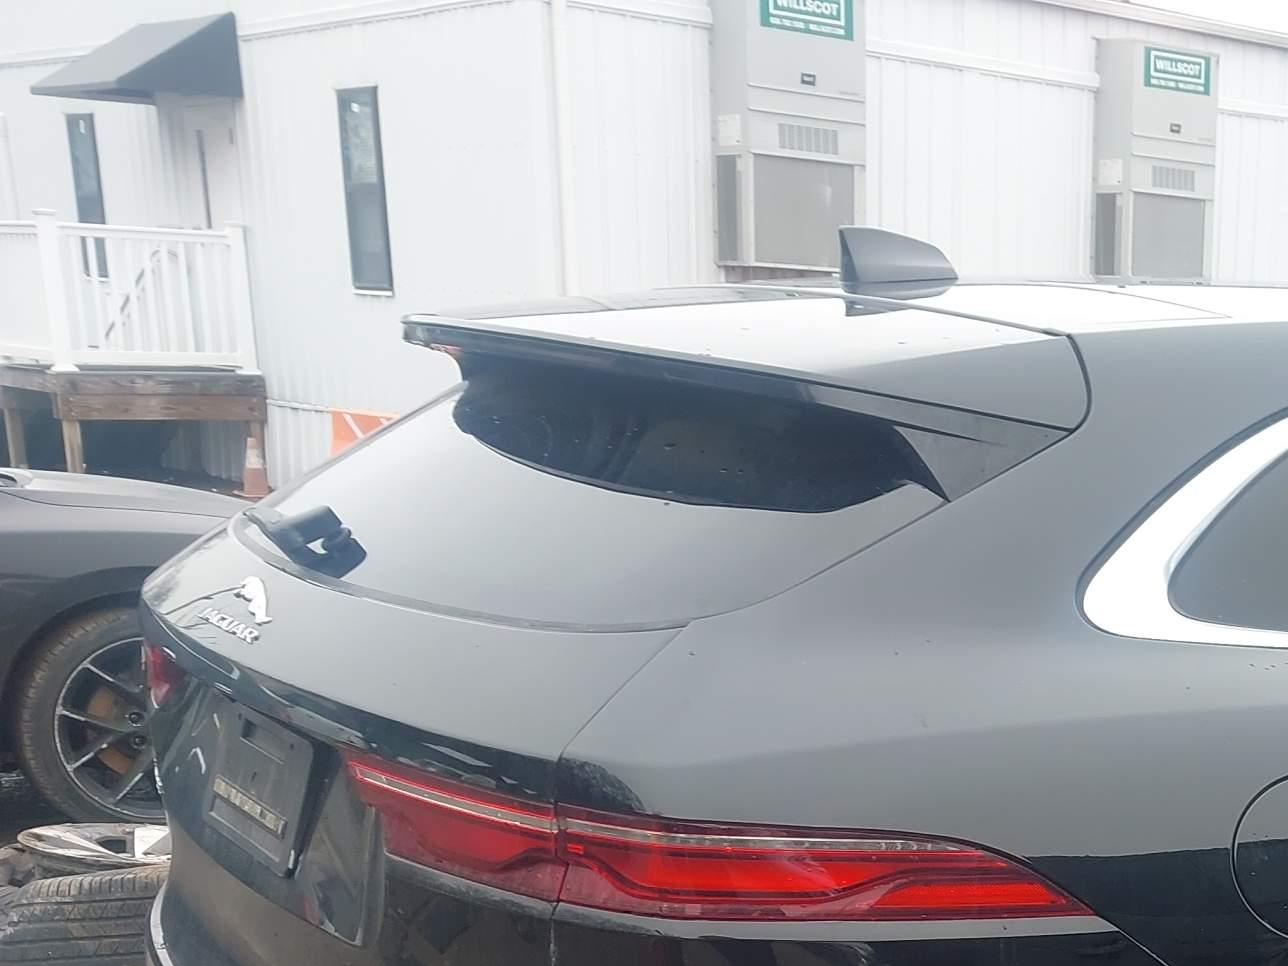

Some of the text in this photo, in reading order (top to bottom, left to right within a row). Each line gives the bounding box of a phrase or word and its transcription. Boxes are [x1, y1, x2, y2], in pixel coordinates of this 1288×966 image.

[776, 0, 839, 16] WILLSCOT
[1155, 58, 1201, 77] WILLSCOT
[197, 607, 259, 645] JAGUAR
